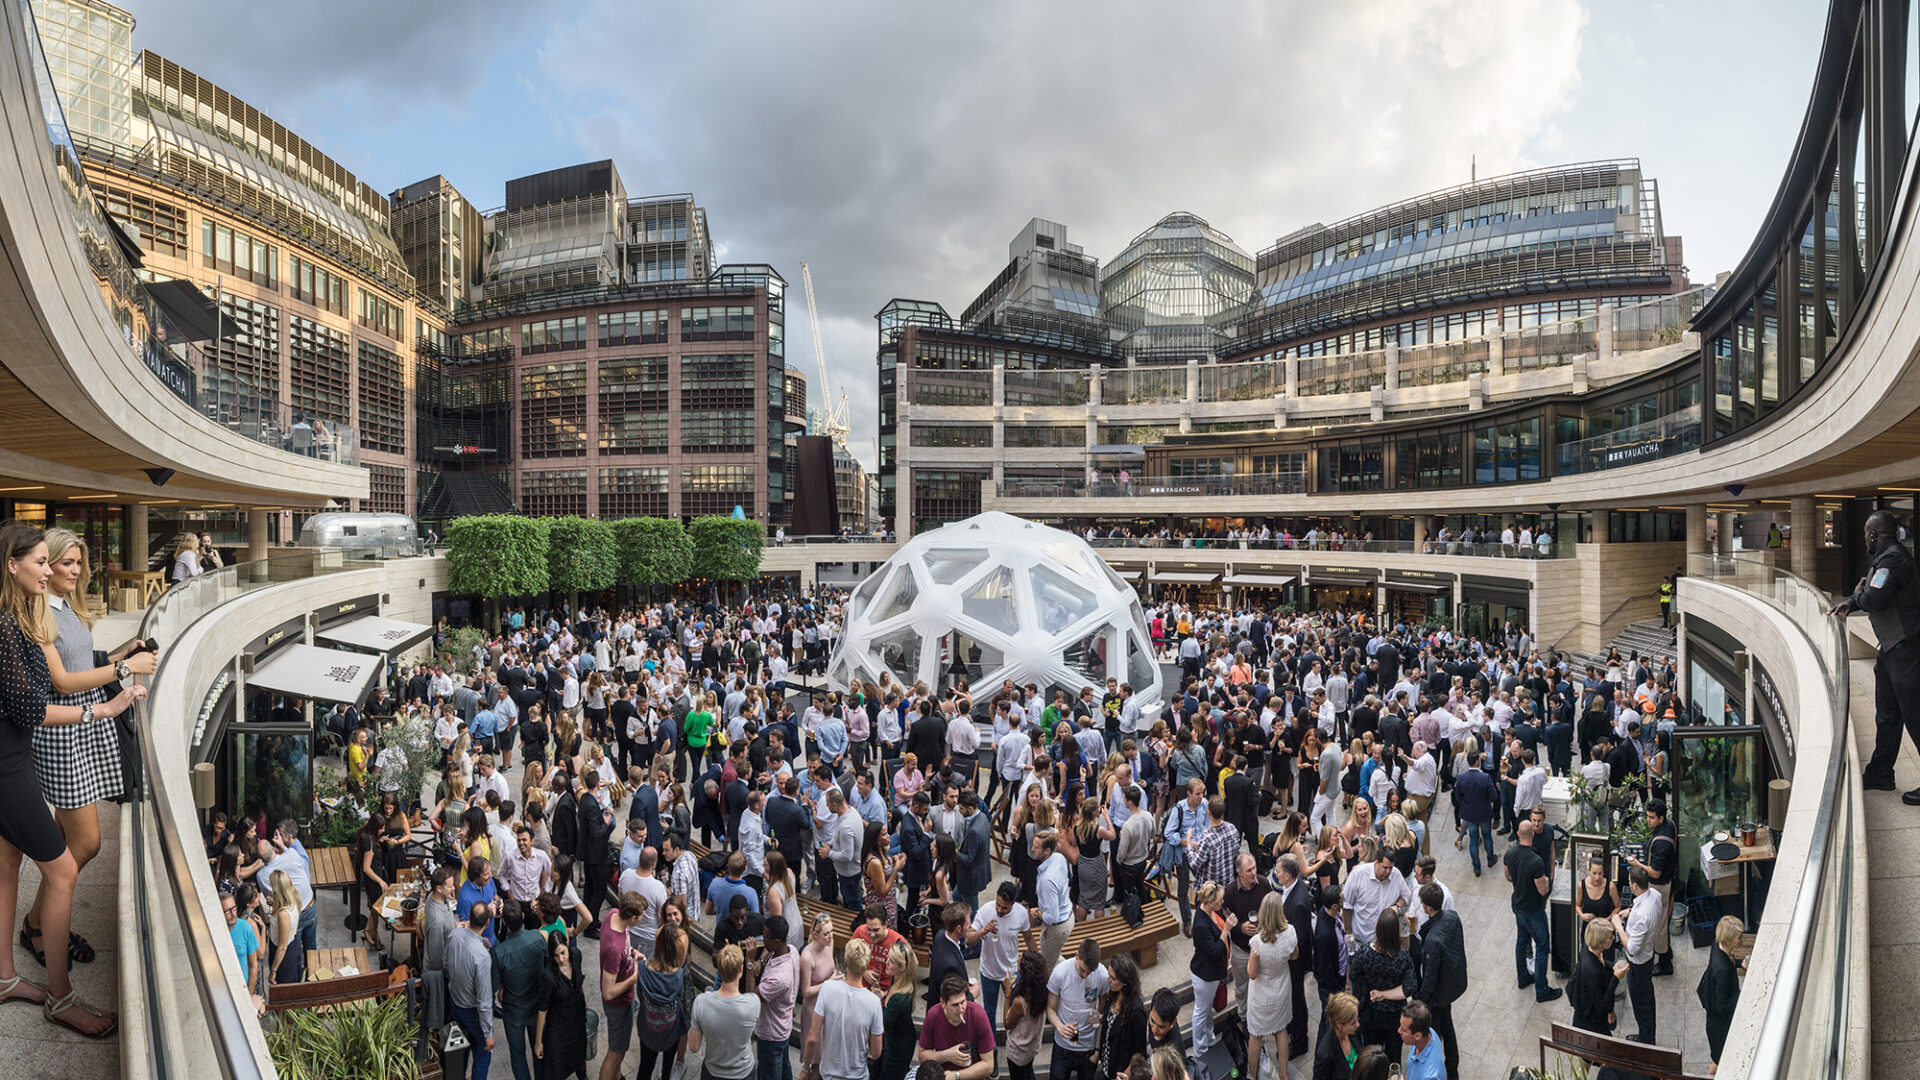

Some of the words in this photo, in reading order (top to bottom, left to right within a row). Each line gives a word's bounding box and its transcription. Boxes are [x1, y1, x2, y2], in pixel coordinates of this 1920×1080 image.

[146, 347, 186, 396] YAUATCHA
[463, 445, 480, 454] UBS
[1624, 443, 1659, 458] YAUATCHA
